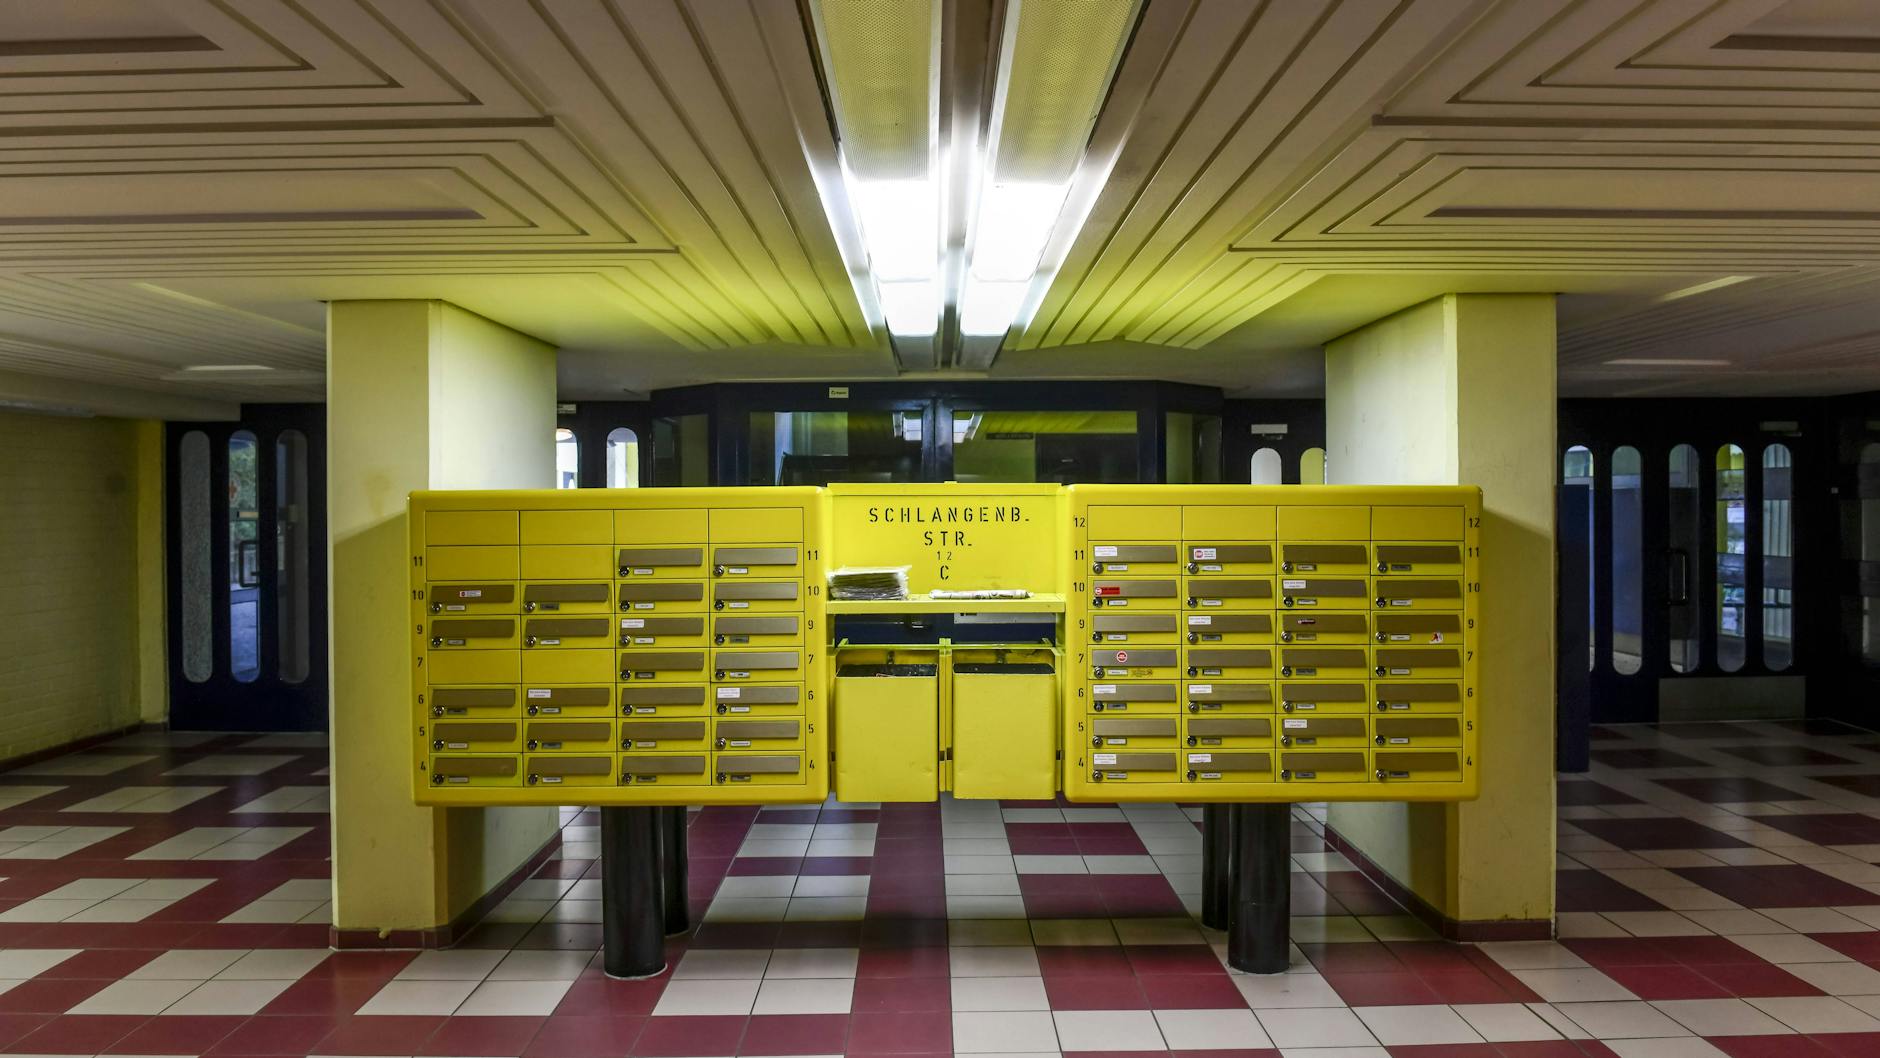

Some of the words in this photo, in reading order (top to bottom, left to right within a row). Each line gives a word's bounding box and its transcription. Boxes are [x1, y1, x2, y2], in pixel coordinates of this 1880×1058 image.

[869, 506, 1029, 523] SCHLANGENB.
[1074, 517, 1086, 528] 12
[1468, 517, 1481, 528] 12
[924, 530, 972, 547] STR.
[807, 550, 818, 561] 11
[936, 551, 952, 561] 12
[1074, 549, 1084, 561] 11
[1468, 546, 1480, 558] 11
[413, 556, 423, 566] 11
[940, 565, 949, 580] C
[807, 585, 820, 596] 10
[1073, 581, 1085, 593] 10
[1467, 582, 1481, 593] 10
[412, 589, 424, 601] 10
